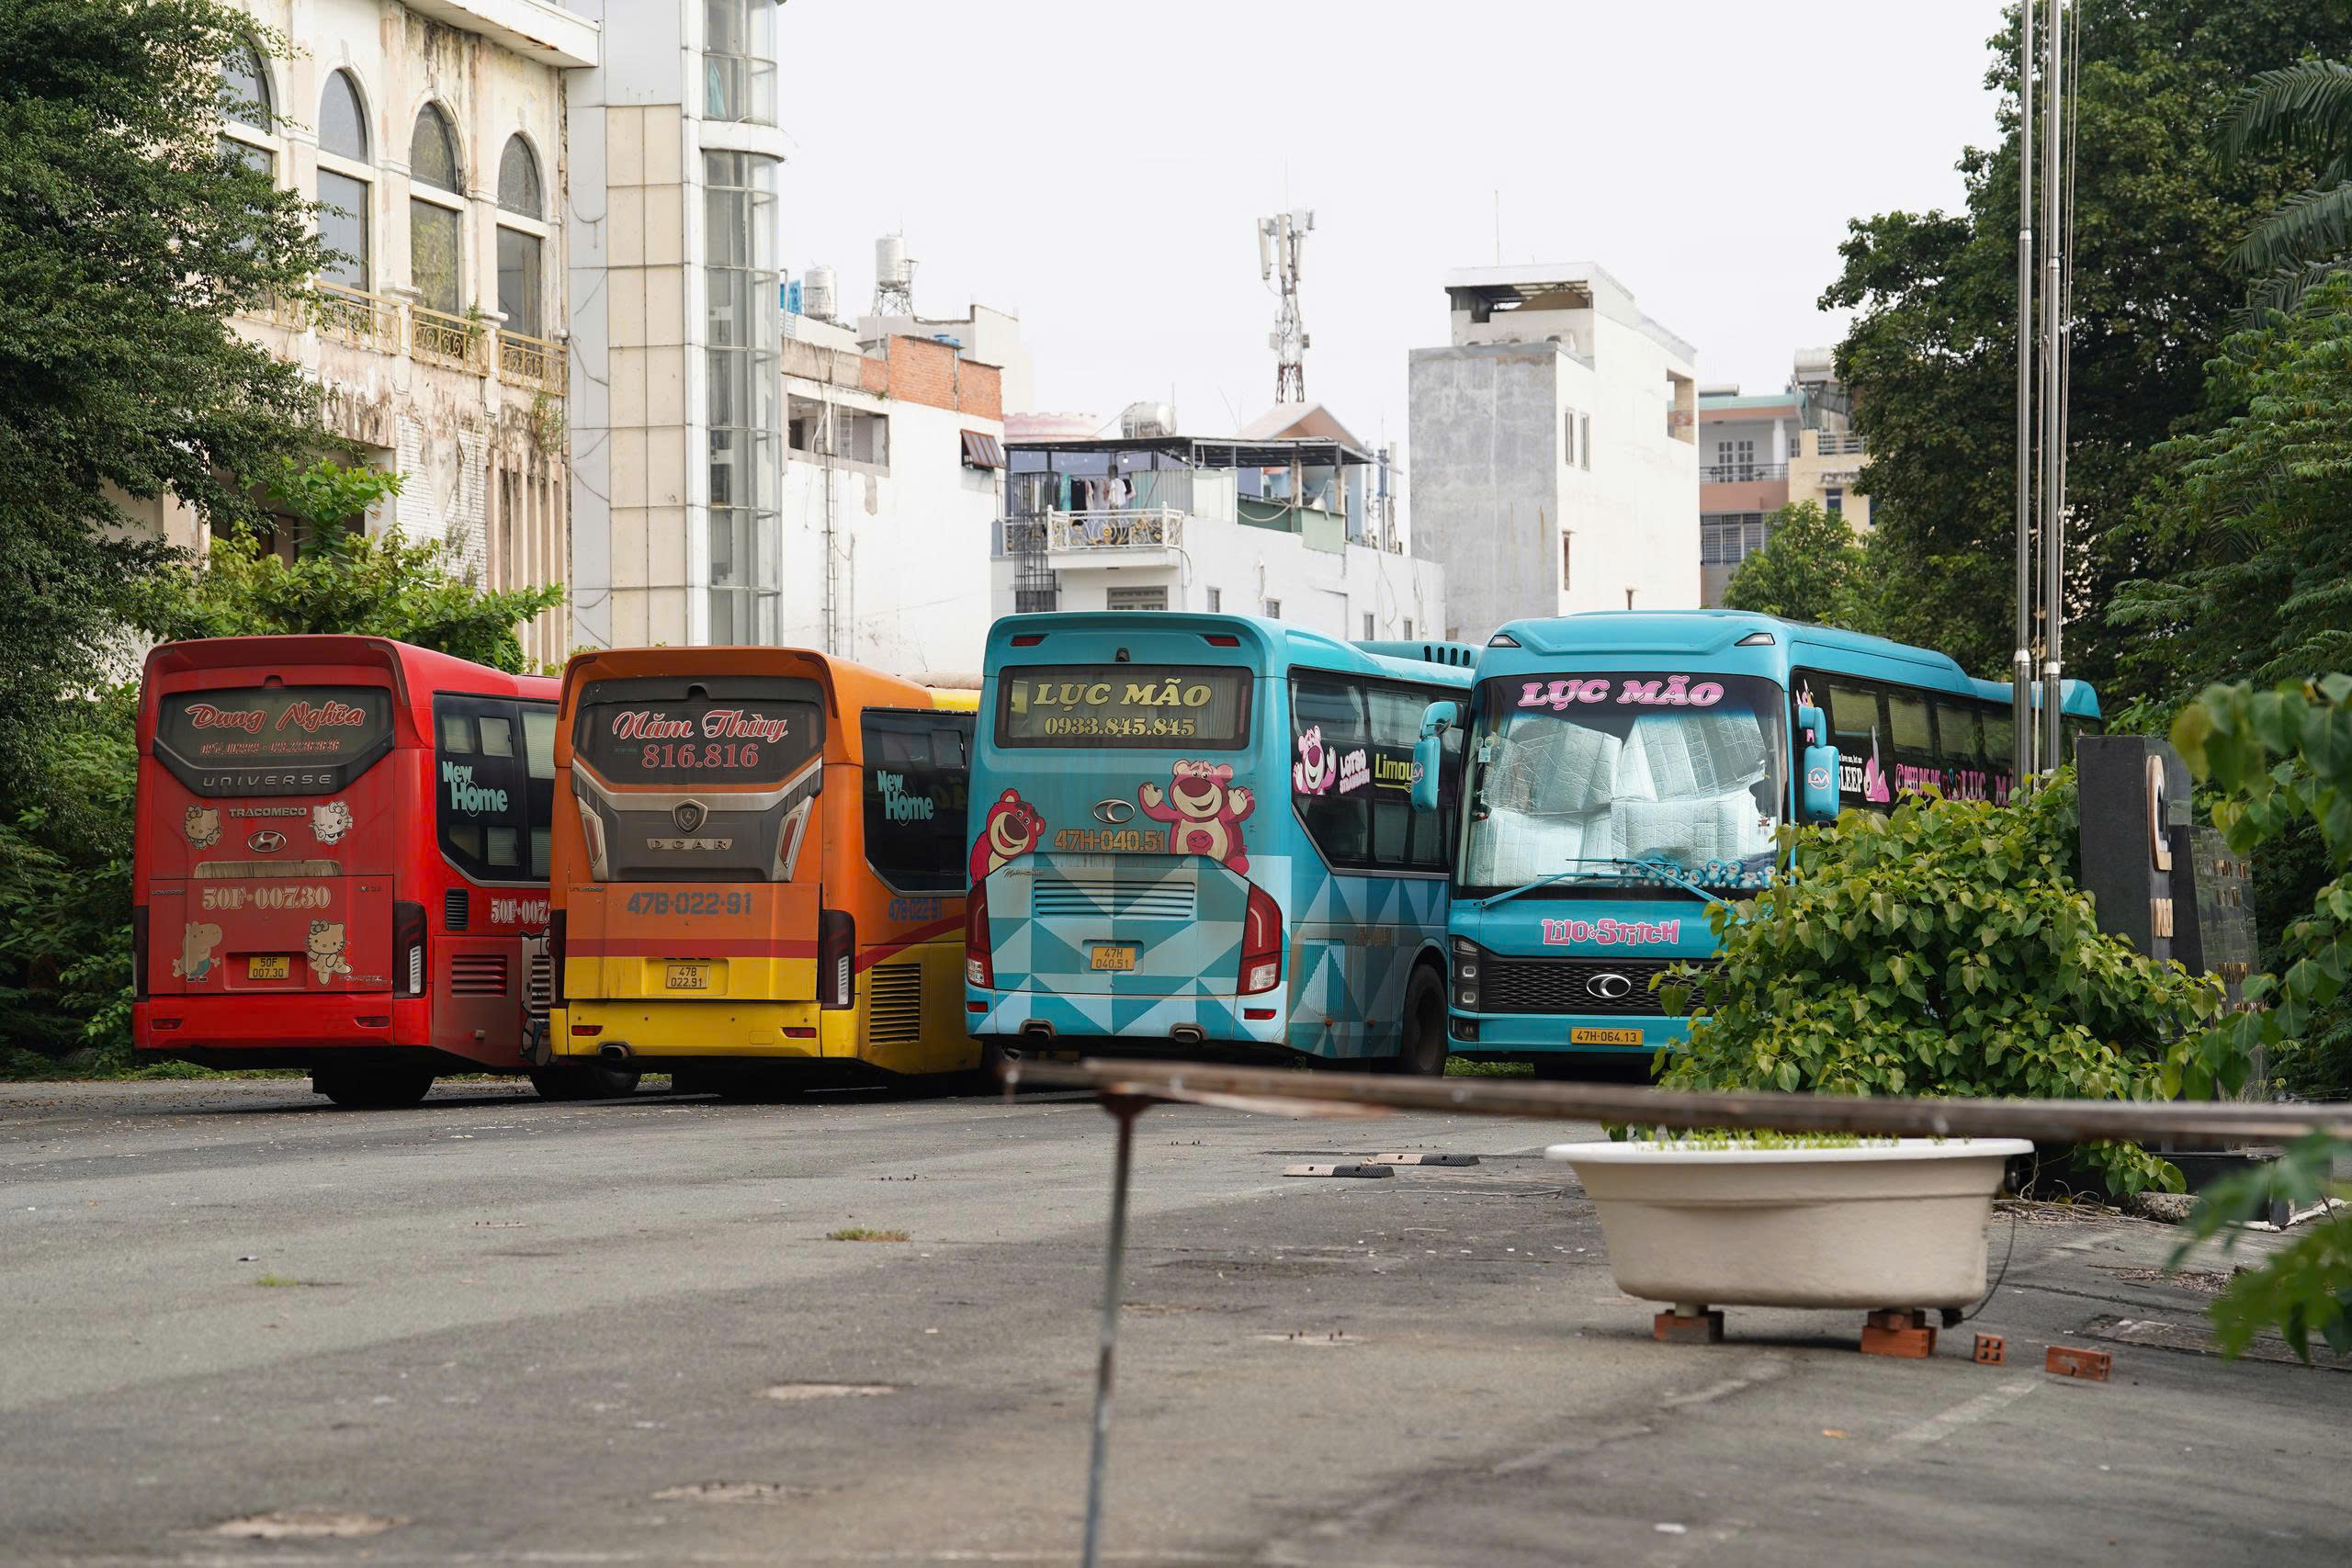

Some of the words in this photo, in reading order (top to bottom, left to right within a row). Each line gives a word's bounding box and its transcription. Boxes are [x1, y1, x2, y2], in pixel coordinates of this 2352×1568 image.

[1034, 683, 1112, 712] LỤC
[1120, 678, 1212, 706] MÃO
[1518, 679, 1610, 711] LỤC
[1616, 675, 1724, 706] MÃO
[185, 704, 267, 734] Dung
[613, 711, 695, 739] Năm
[702, 710, 788, 743] Thùy
[1045, 716, 1195, 736] 0933.845.845
[642, 743, 759, 768] 816.816
[203, 775, 332, 787] UNIVERSE
[443, 761, 472, 783] New
[877, 770, 903, 792] New
[1838, 765, 1863, 793] LEEP
[451, 782, 508, 814] Home
[886, 792, 934, 822] Home
[229, 807, 307, 818] TRACOMECO
[650, 840, 727, 849] DCAR
[1054, 829, 1165, 852] 47H-040.51
[260, 957, 277, 967] 50F
[1096, 958, 1129, 969] 040.51
[1103, 948, 1124, 959] 47H
[253, 968, 284, 978] 007.30
[671, 977, 703, 987] 022.91
[679, 967, 697, 977] 47B
[1577, 1031, 1636, 1043] 47H-064.13
